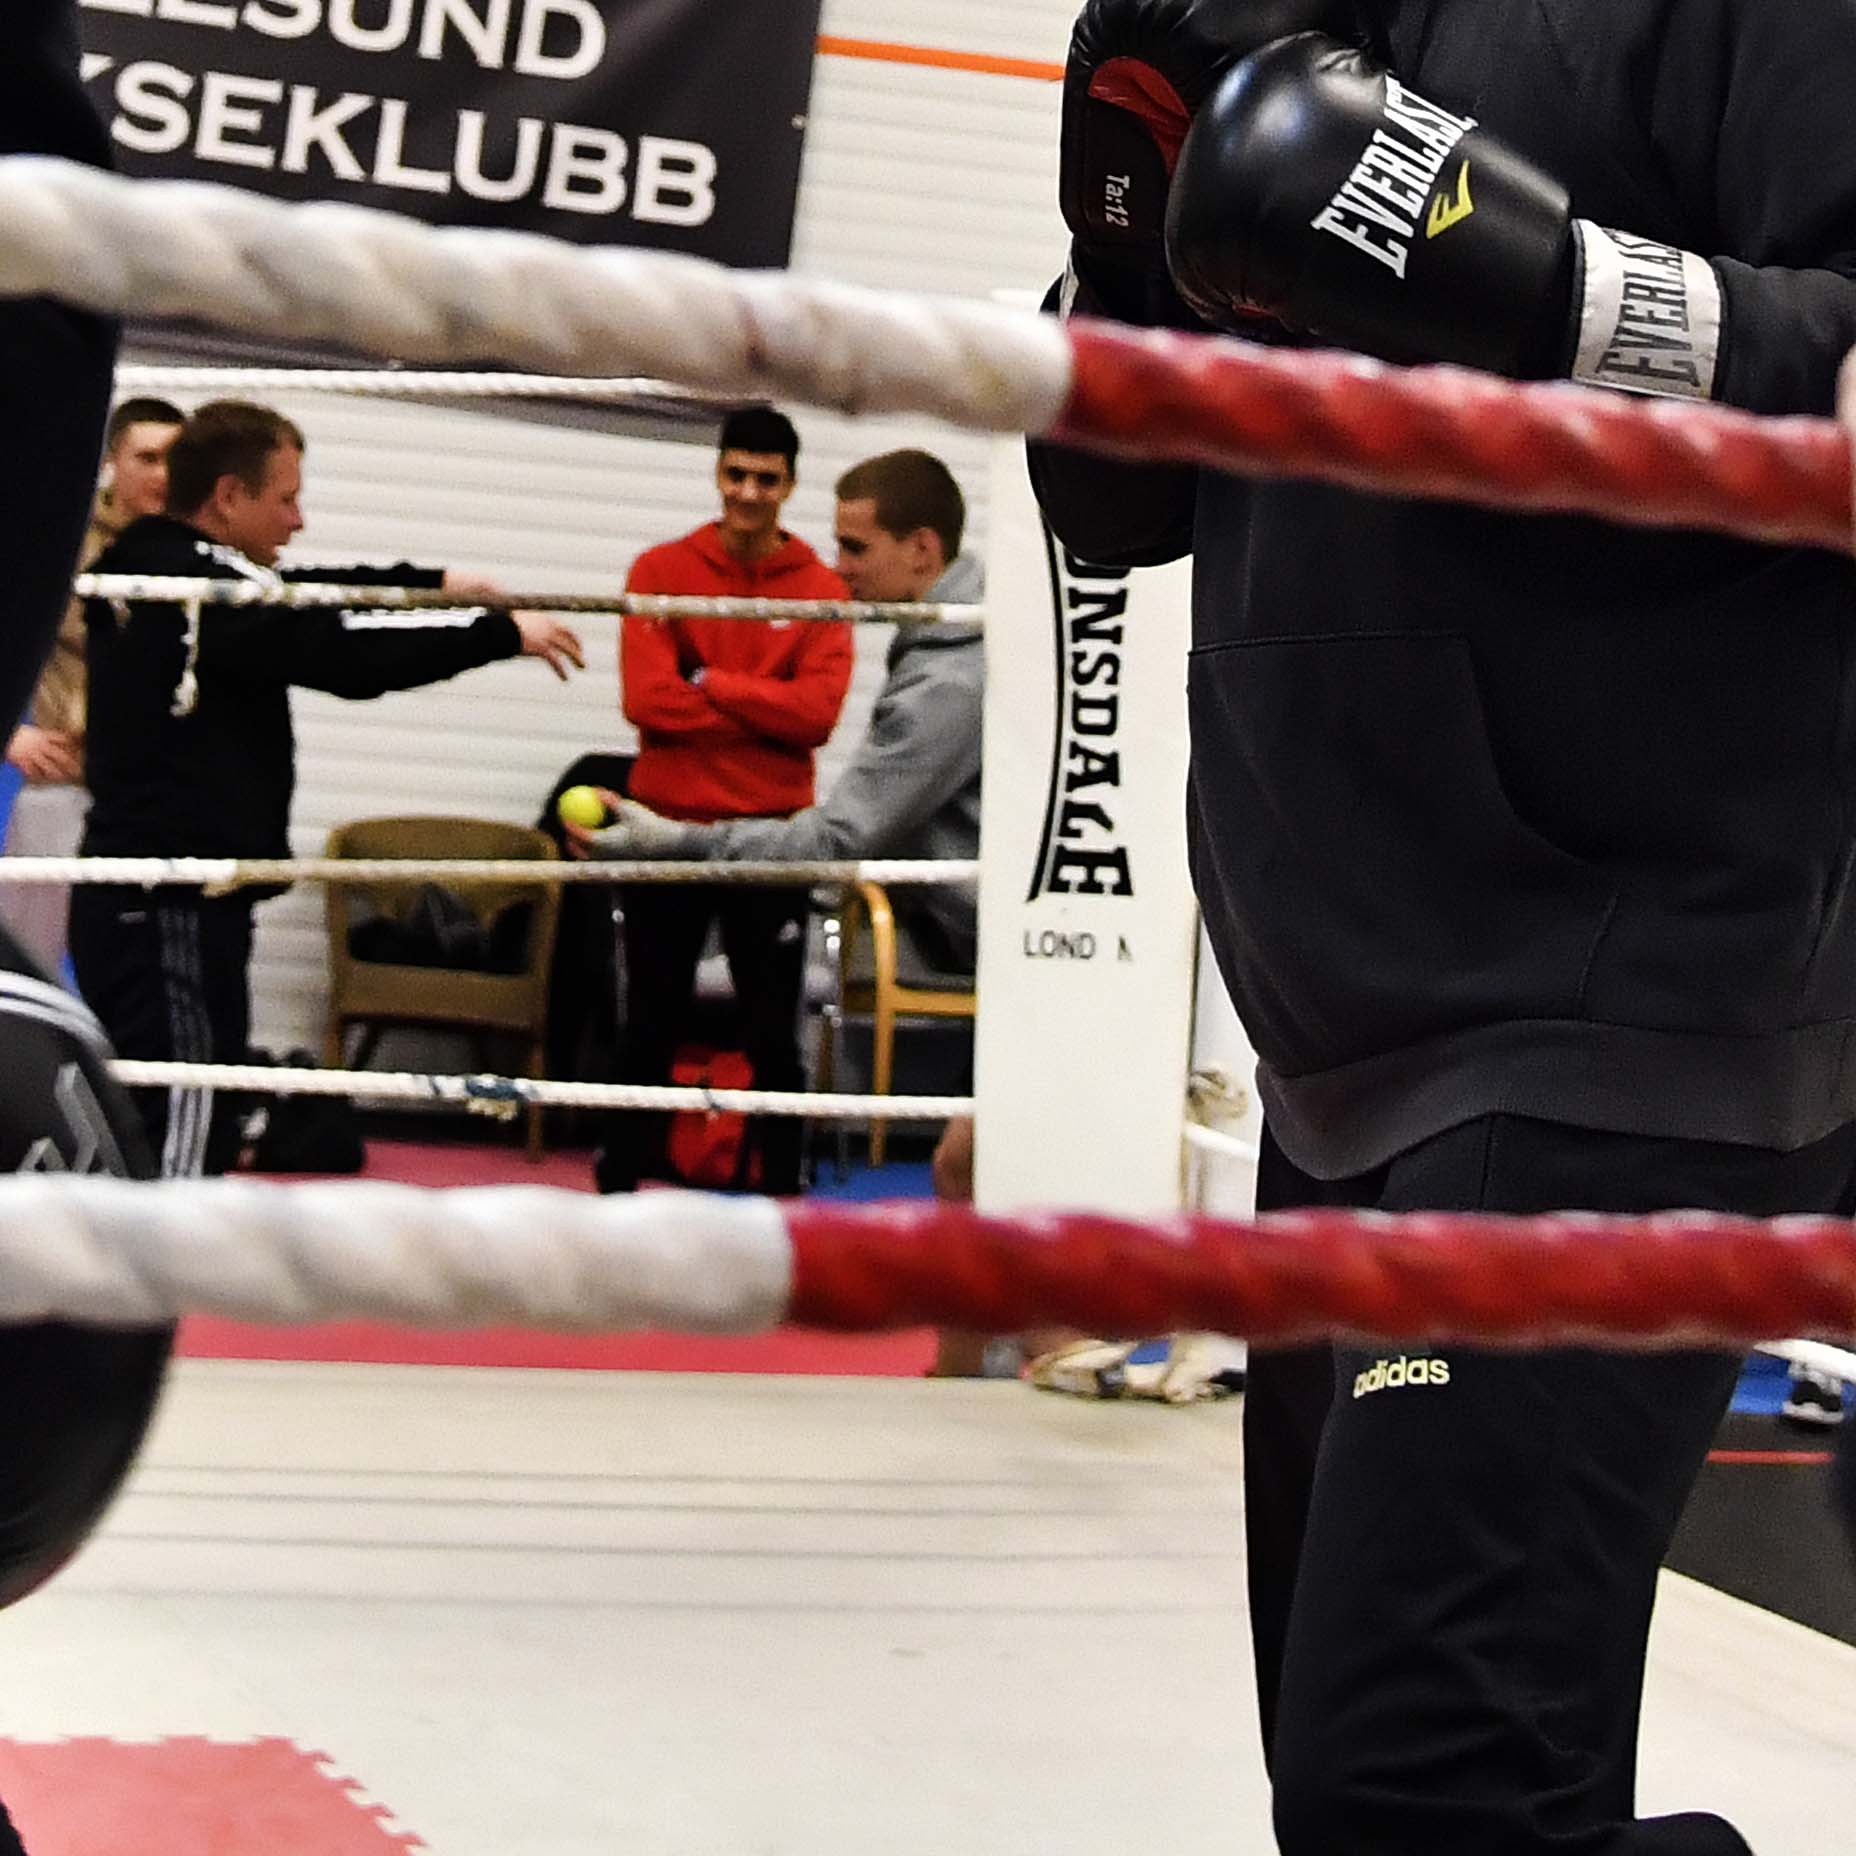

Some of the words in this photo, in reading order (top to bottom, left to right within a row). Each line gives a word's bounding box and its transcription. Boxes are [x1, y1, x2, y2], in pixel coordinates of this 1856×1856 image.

[1104, 174, 1131, 228] Ta:12
[1310, 71, 1479, 280] EVERLAST
[1352, 1354, 1452, 1400] adidas
